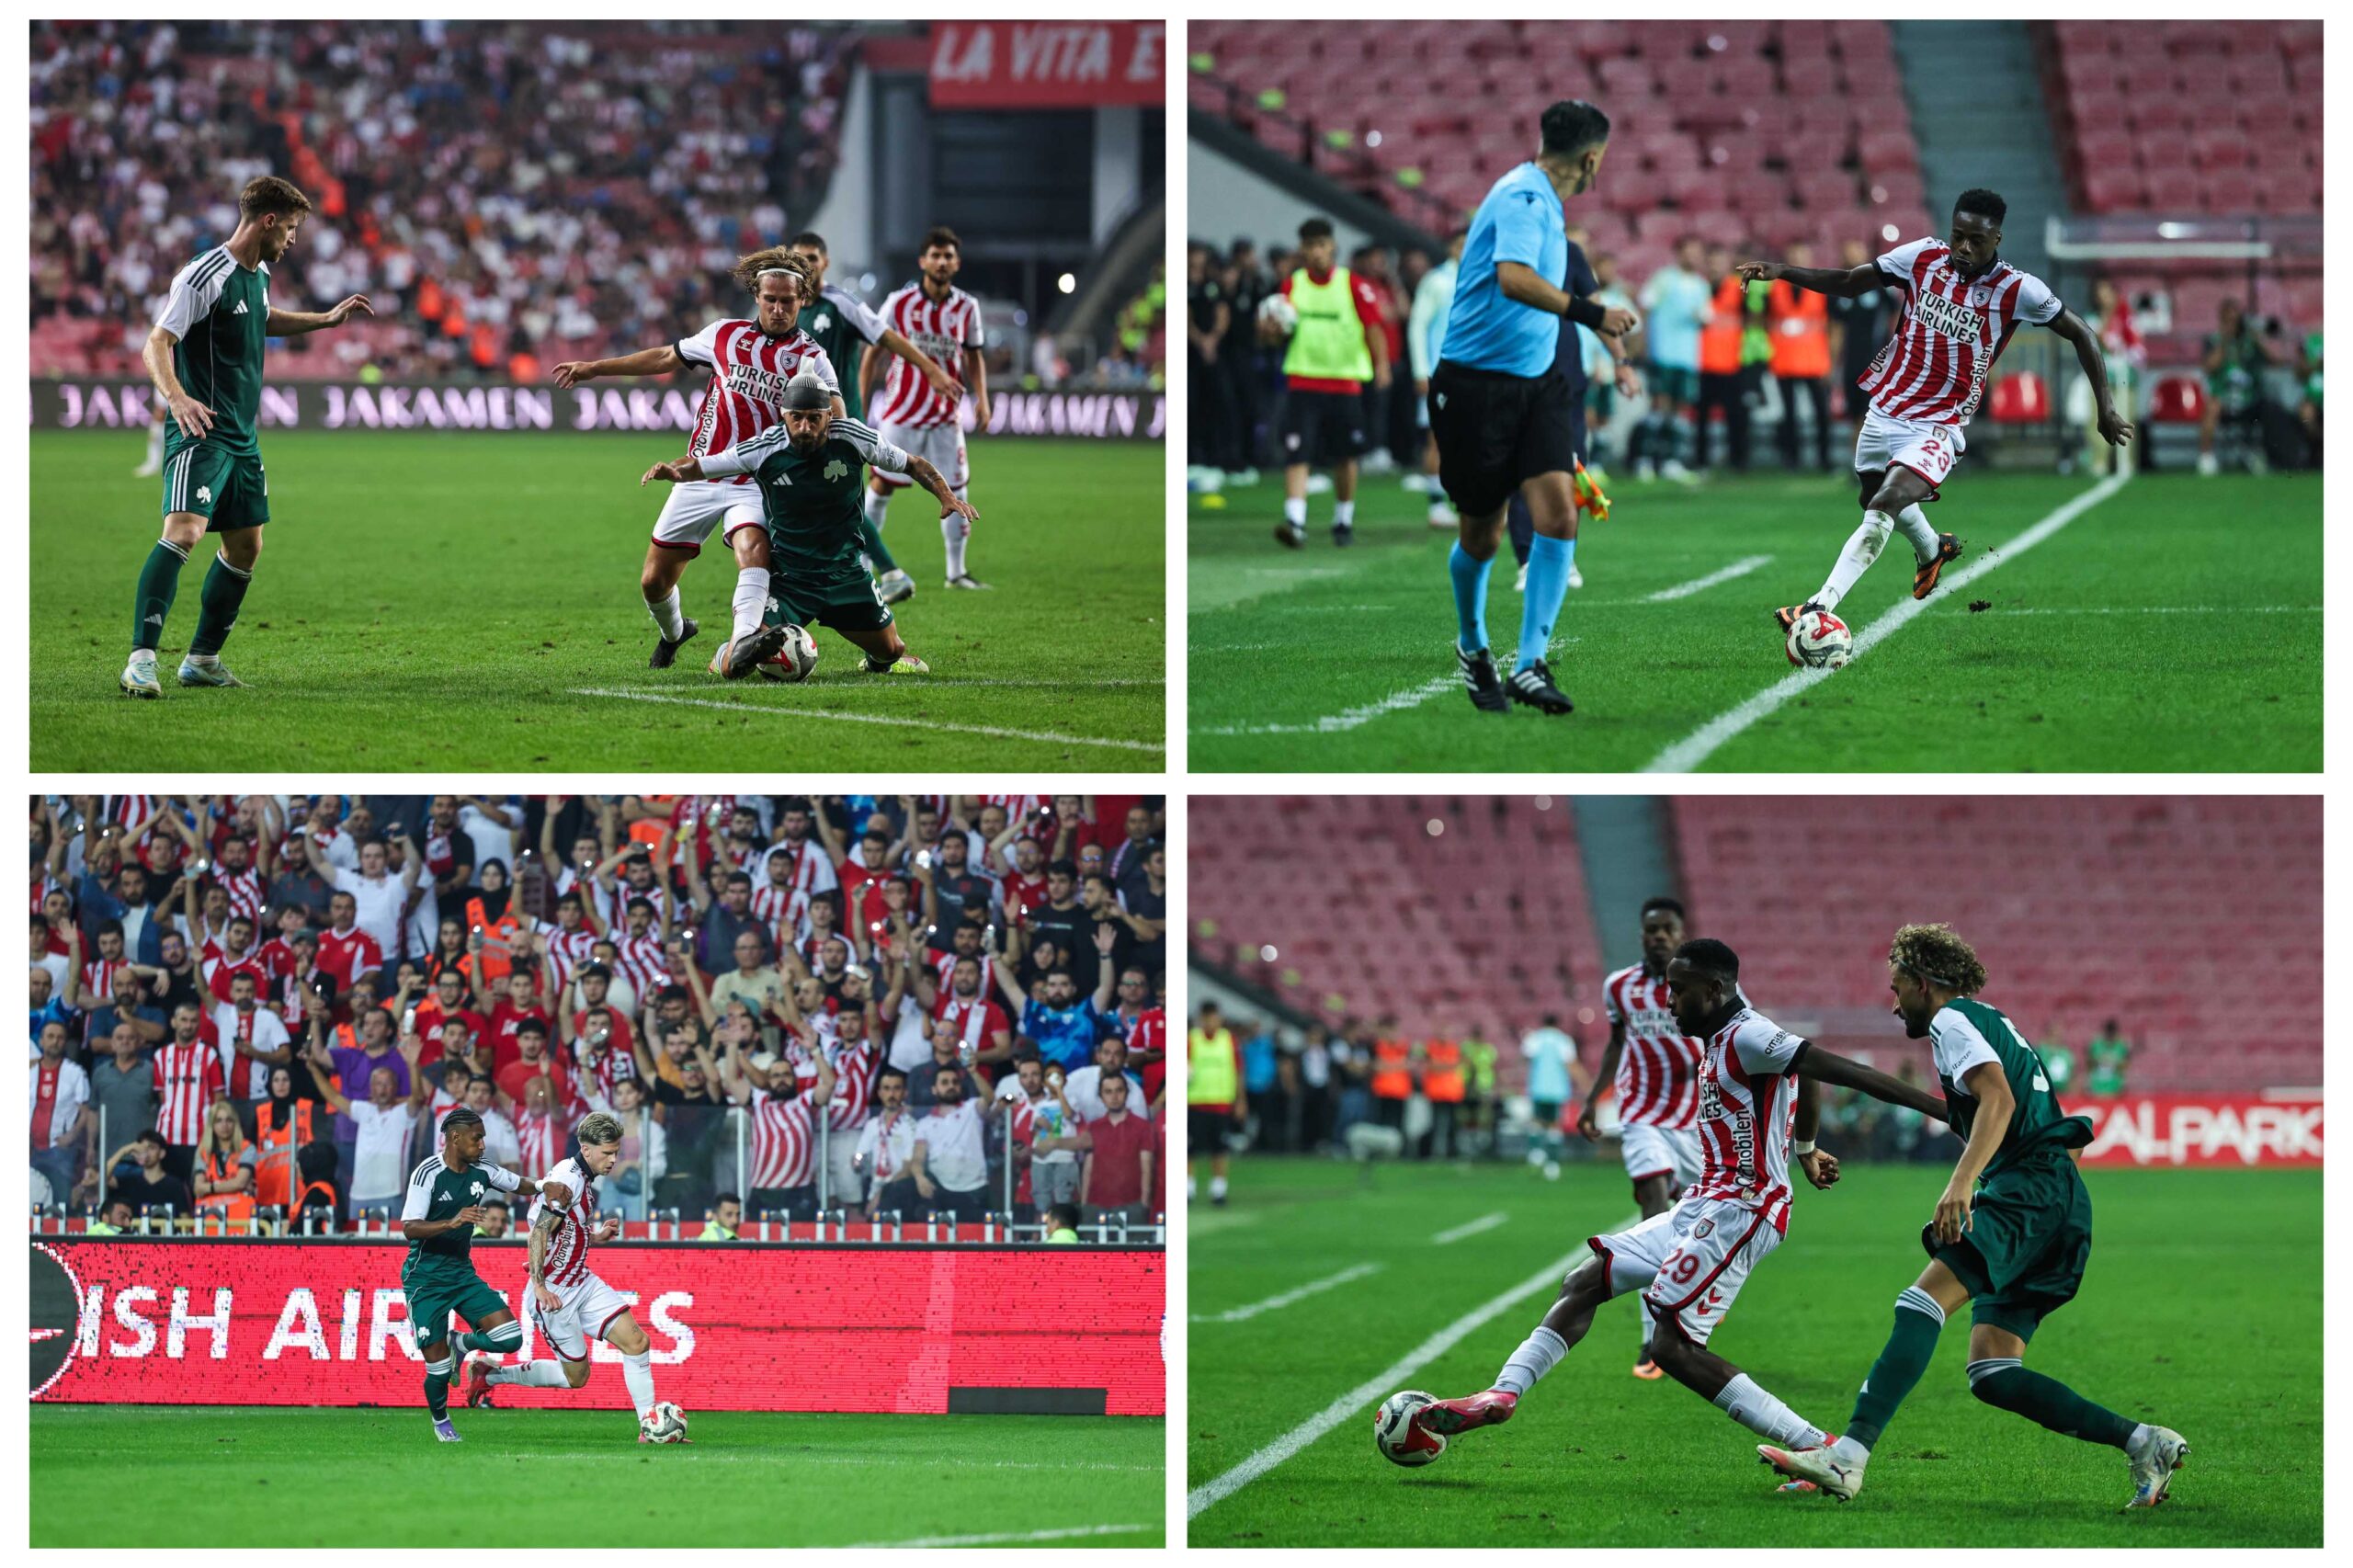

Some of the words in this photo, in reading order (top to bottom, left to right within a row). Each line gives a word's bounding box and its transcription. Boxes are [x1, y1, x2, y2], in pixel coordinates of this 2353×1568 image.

[931, 23, 994, 83] LA
[1011, 22, 1110, 83] VITA
[1914, 305, 1978, 345] AIRLINES
[1919, 288, 1986, 332] TURKISH
[725, 378, 784, 407] AIRLINE
[1961, 344, 1993, 416] Otomobilen
[319, 385, 553, 430] JAKAMEN
[1921, 439, 1950, 472] 23
[870, 578, 884, 608] 6
[1659, 1247, 1700, 1285] 29
